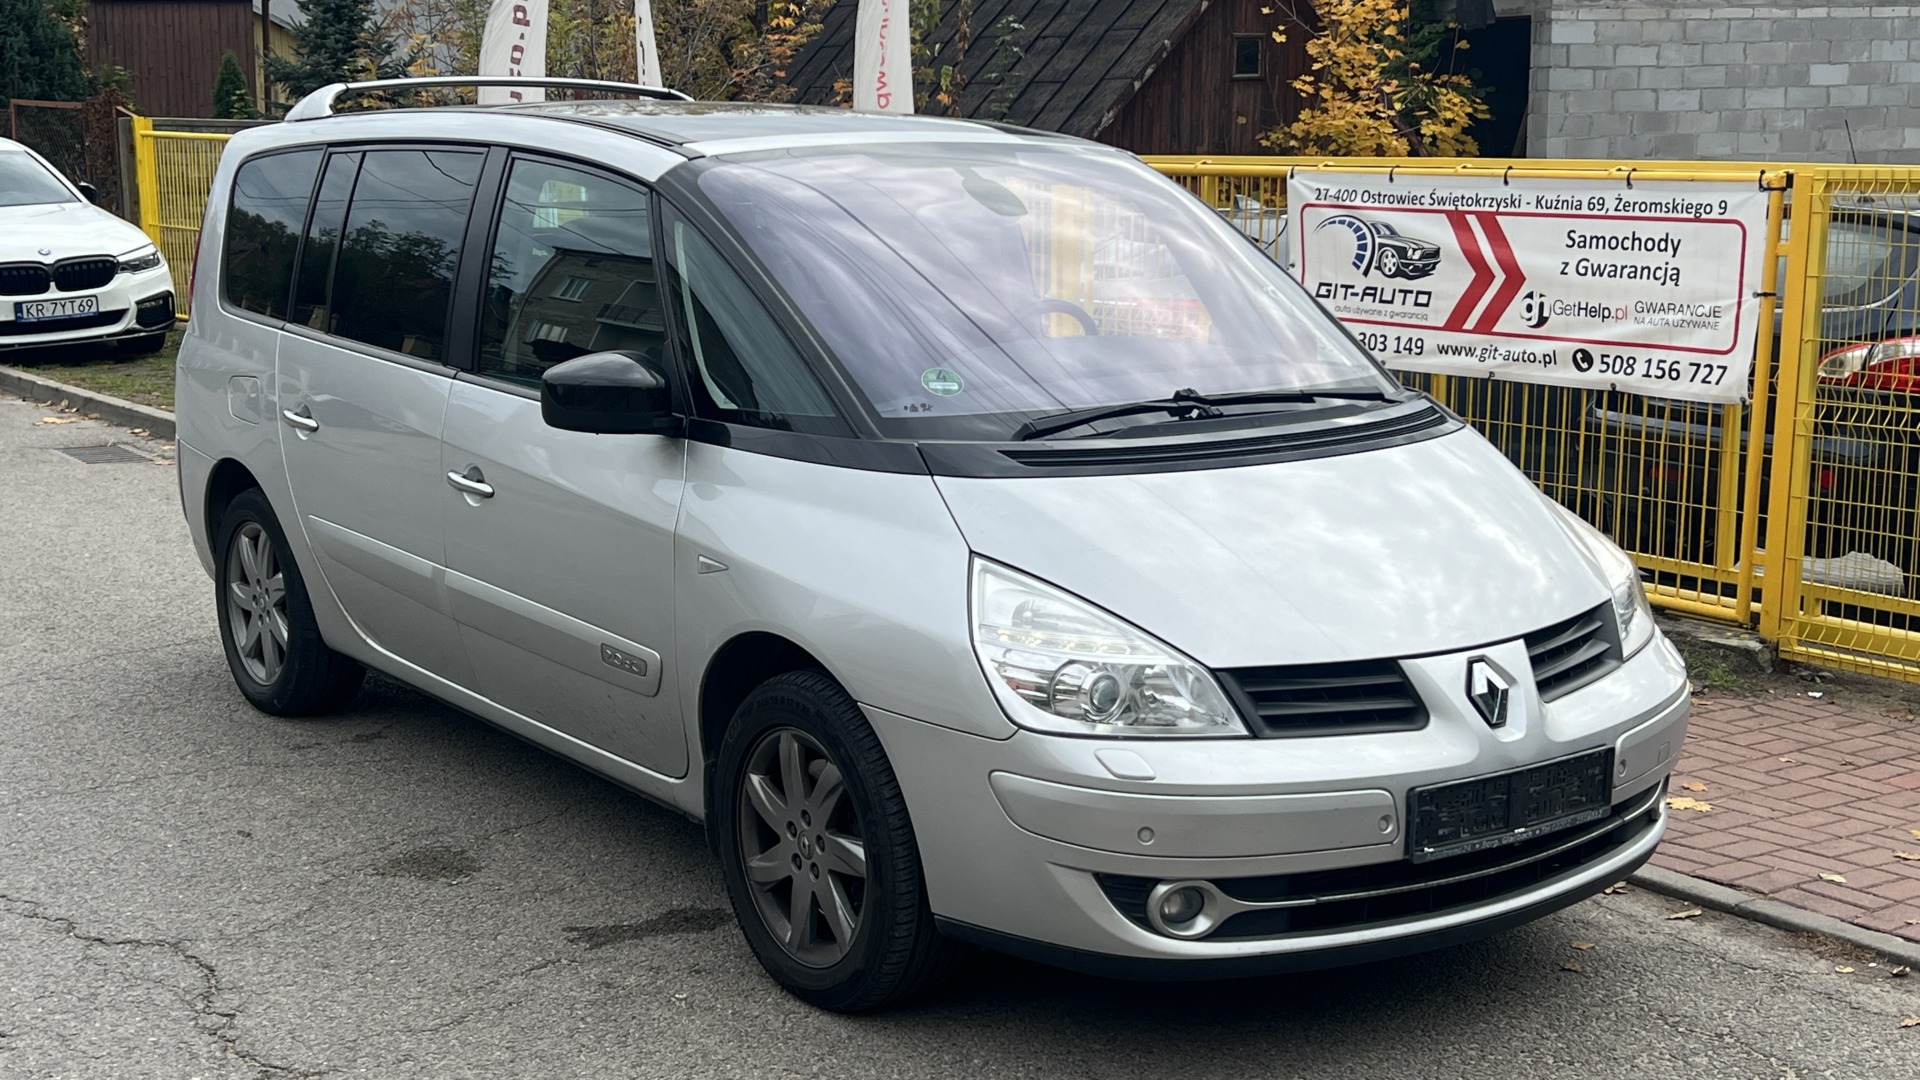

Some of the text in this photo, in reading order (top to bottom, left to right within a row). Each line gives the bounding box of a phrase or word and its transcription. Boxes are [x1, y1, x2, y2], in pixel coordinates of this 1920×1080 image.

[1314, 187, 1357, 203] 27-400
[1360, 189, 1425, 206] Ostrowiec
[1429, 187, 1522, 212] Świętokrzyski
[1535, 194, 1582, 211] Kuźnia
[1587, 196, 1609, 214] 69,
[1614, 193, 1713, 218] Żeromskiego
[1718, 200, 1728, 215] 9
[1565, 229, 1682, 258] Samochody
[1560, 257, 1681, 287] z Gwarancją
[1315, 281, 1432, 308] GIT-AUTO
[25, 303, 45, 318] KR
[50, 298, 94, 316] 7YT69
[1334, 304, 1351, 314] auta
[1383, 309, 1388, 317] z
[1552, 299, 1628, 324] GetHelp.pl
[1634, 300, 1722, 319] GWARANCJE
[1634, 316, 1646, 326] NA
[1647, 317, 1670, 328] AUTA
[1393, 335, 1424, 356] 149
[1436, 343, 1557, 368] www.git-auto.pl
[1598, 353, 1728, 386] 508 156 727
